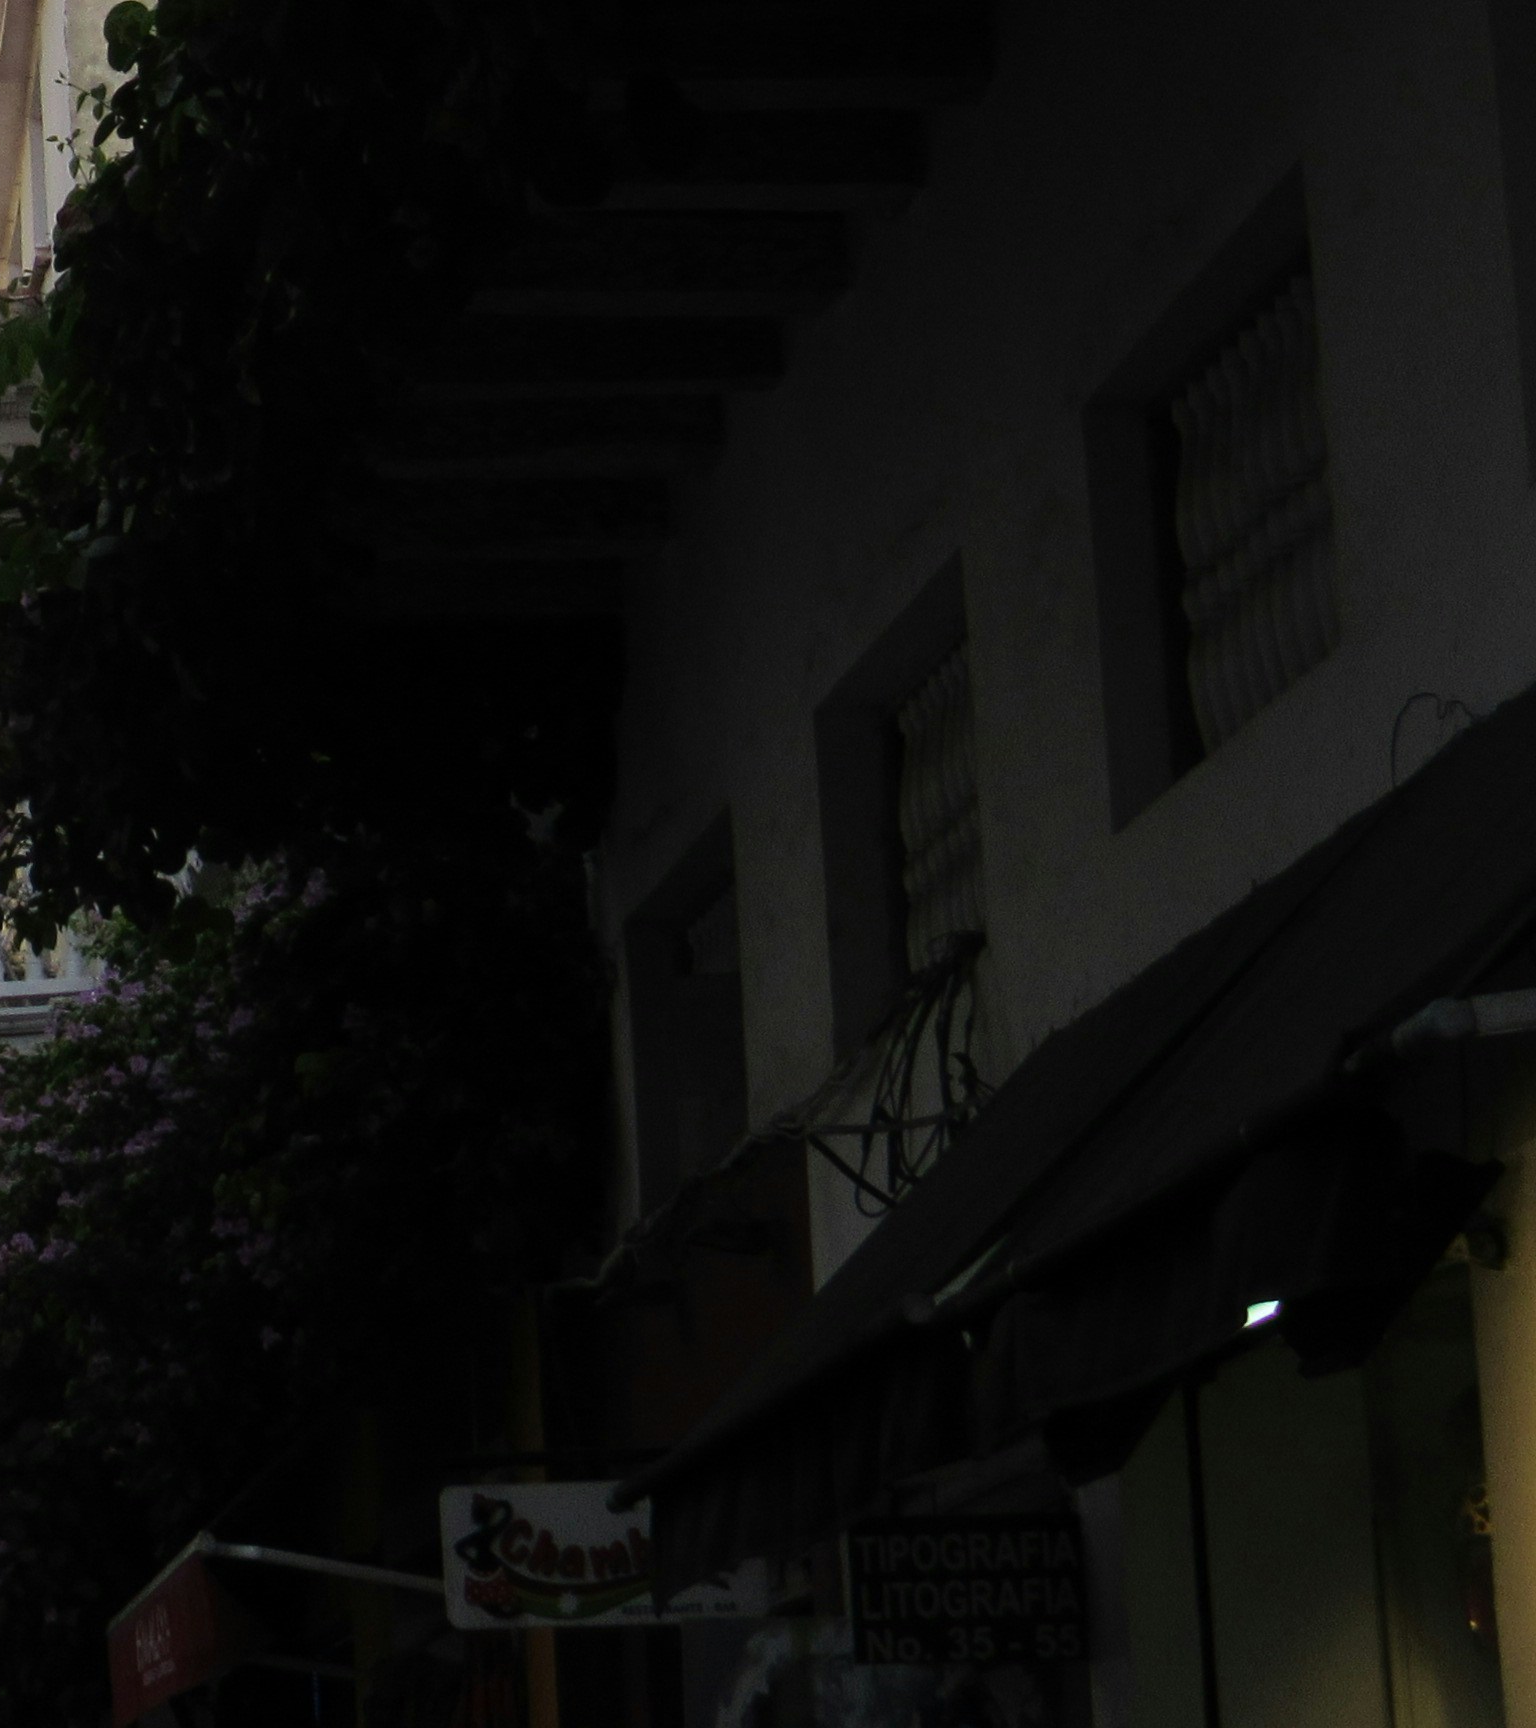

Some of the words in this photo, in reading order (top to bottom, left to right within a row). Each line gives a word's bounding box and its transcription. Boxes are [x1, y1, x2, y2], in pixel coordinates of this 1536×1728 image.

[499, 1518, 656, 1580] Chamb
[854, 1530, 1078, 1573] TIPOGRAFIA
[860, 1577, 1081, 1620] LITOGRAFIA
[863, 1628, 933, 1662] No.
[947, 1626, 996, 1661] 35
[1035, 1623, 1082, 1661] 55
